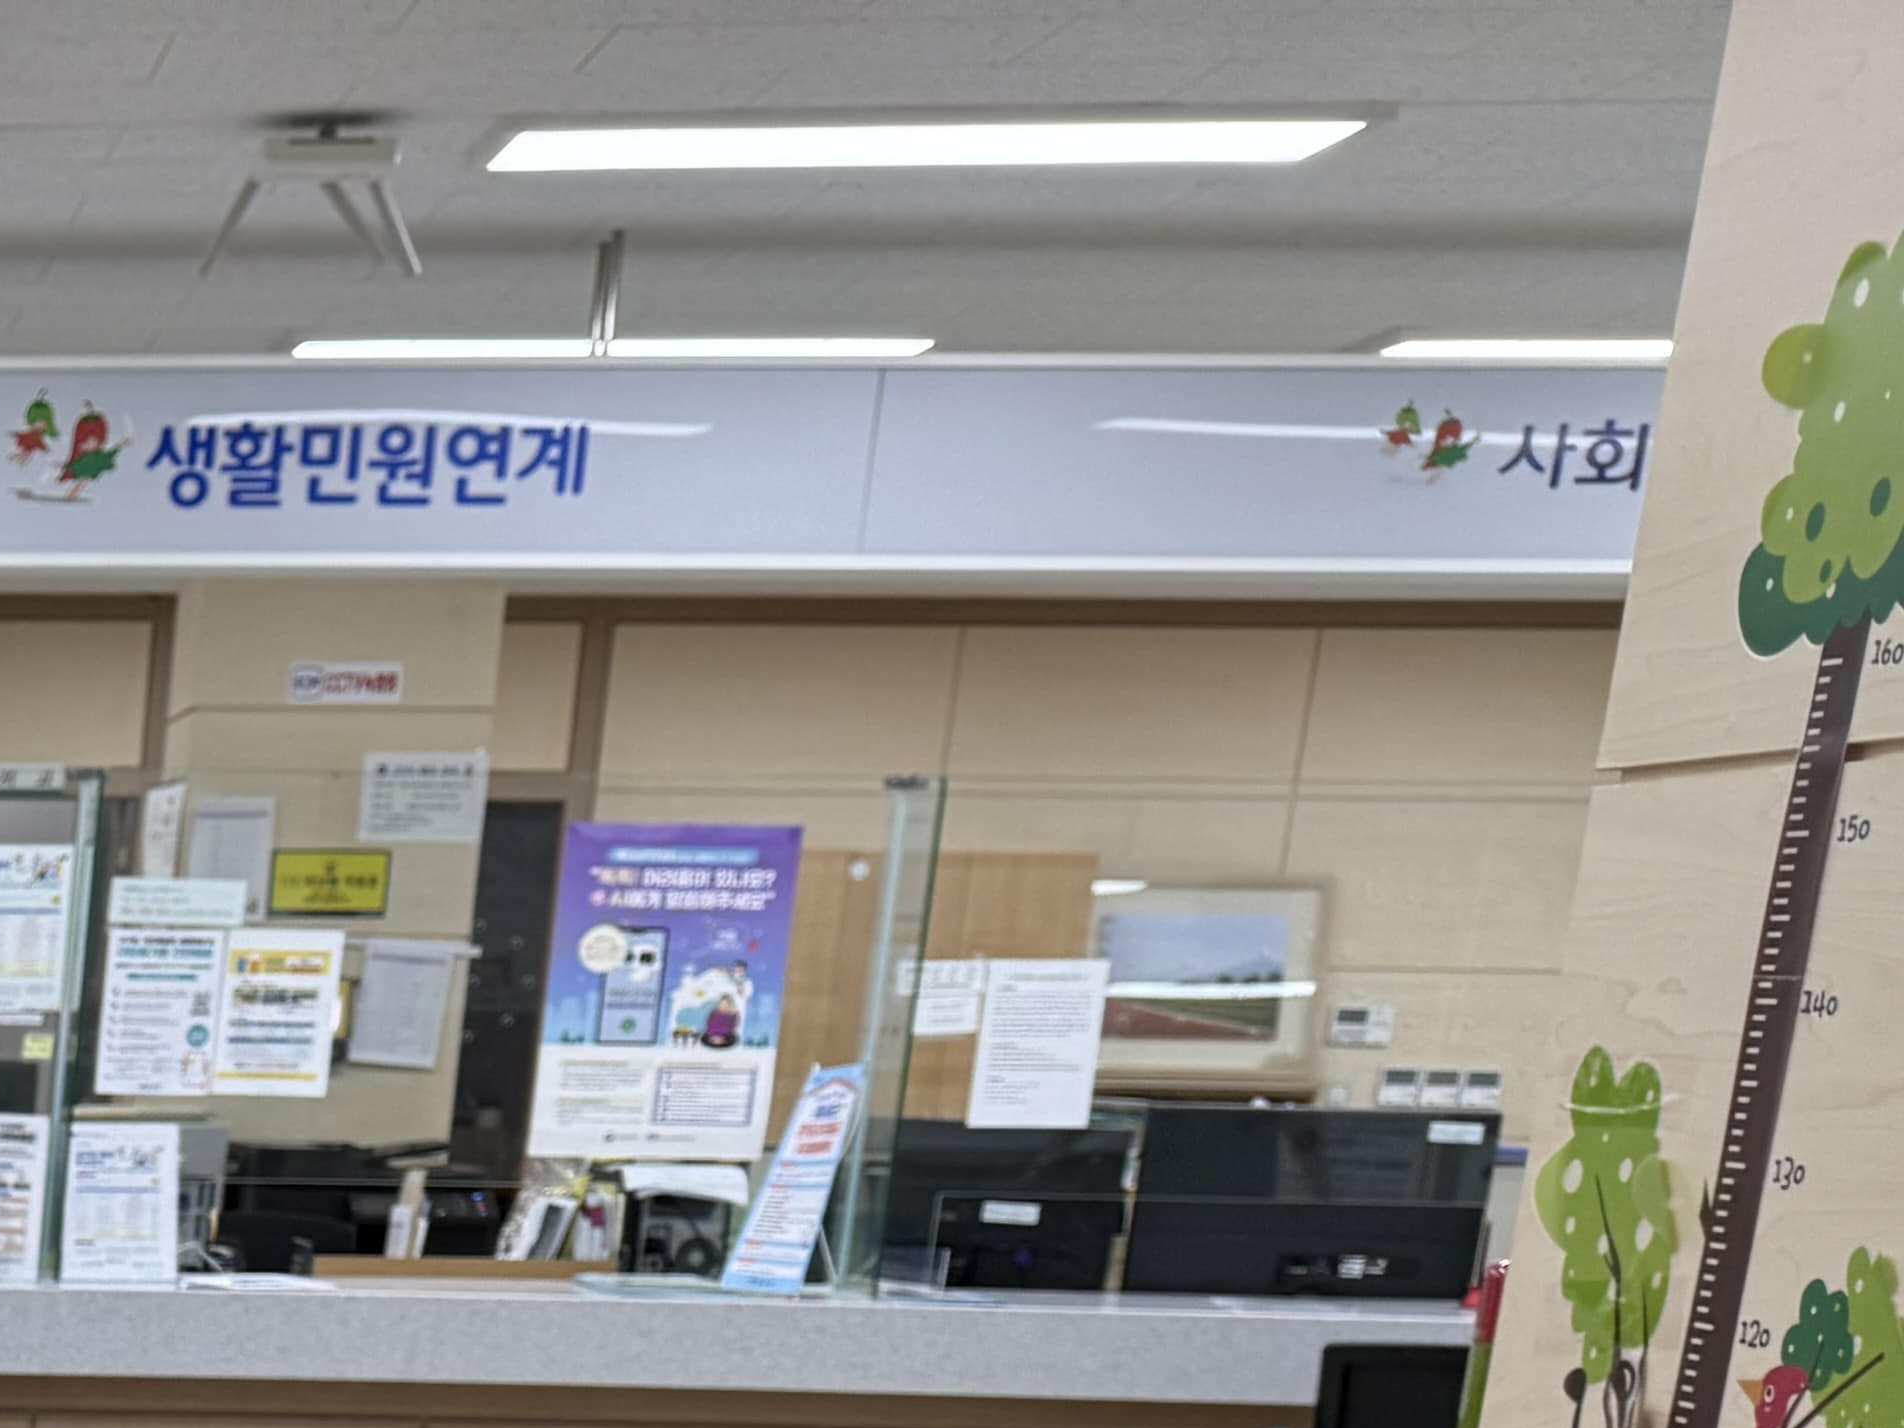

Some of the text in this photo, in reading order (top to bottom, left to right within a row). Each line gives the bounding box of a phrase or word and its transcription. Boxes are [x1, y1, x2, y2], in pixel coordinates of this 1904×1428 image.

[146, 421, 590, 507] 생활민원연계
[1498, 420, 1651, 491] 사회
[1871, 640, 1904, 665] 160
[1837, 817, 1870, 842] 150
[1800, 990, 1838, 1017] 140
[1773, 1157, 1805, 1189] 130
[1739, 1319, 1770, 1348] 120
